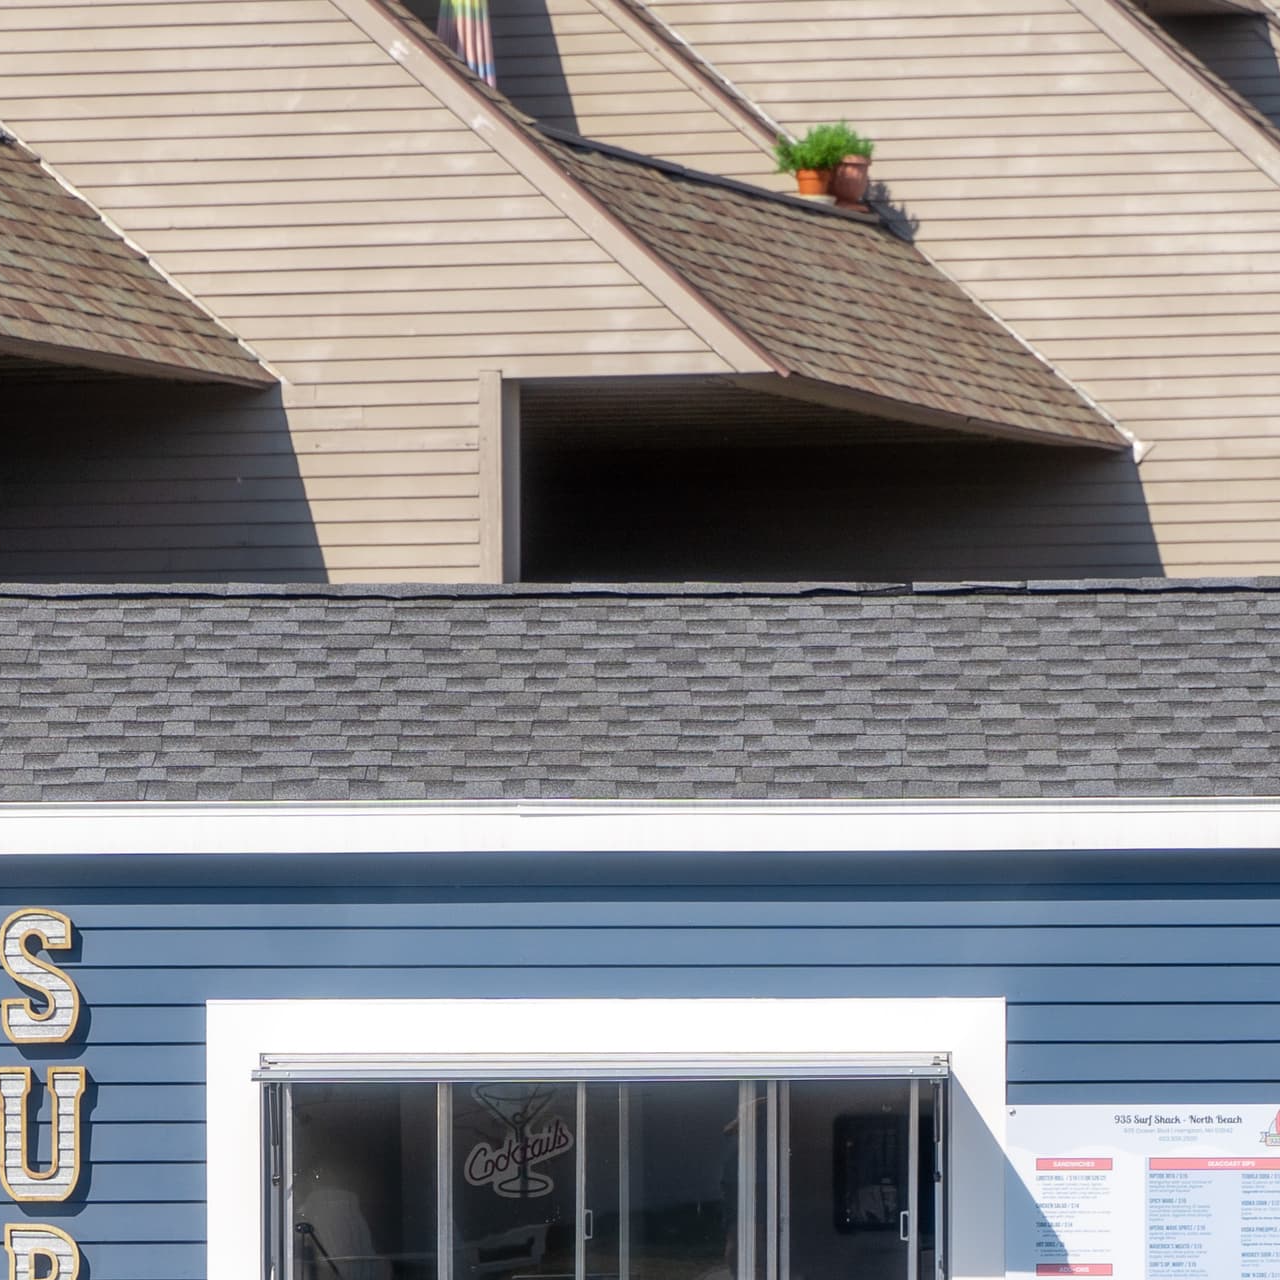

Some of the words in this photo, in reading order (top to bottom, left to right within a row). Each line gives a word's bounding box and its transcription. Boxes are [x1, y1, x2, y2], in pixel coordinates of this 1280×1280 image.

[1114, 1115, 1131, 1124] 935
[1134, 1115, 1152, 1126] Surf
[1154, 1115, 1181, 1124] Shack
[1189, 1115, 1213, 1124] North
[1216, 1115, 1243, 1124] Beach
[469, 1120, 569, 1181] Cocktails
